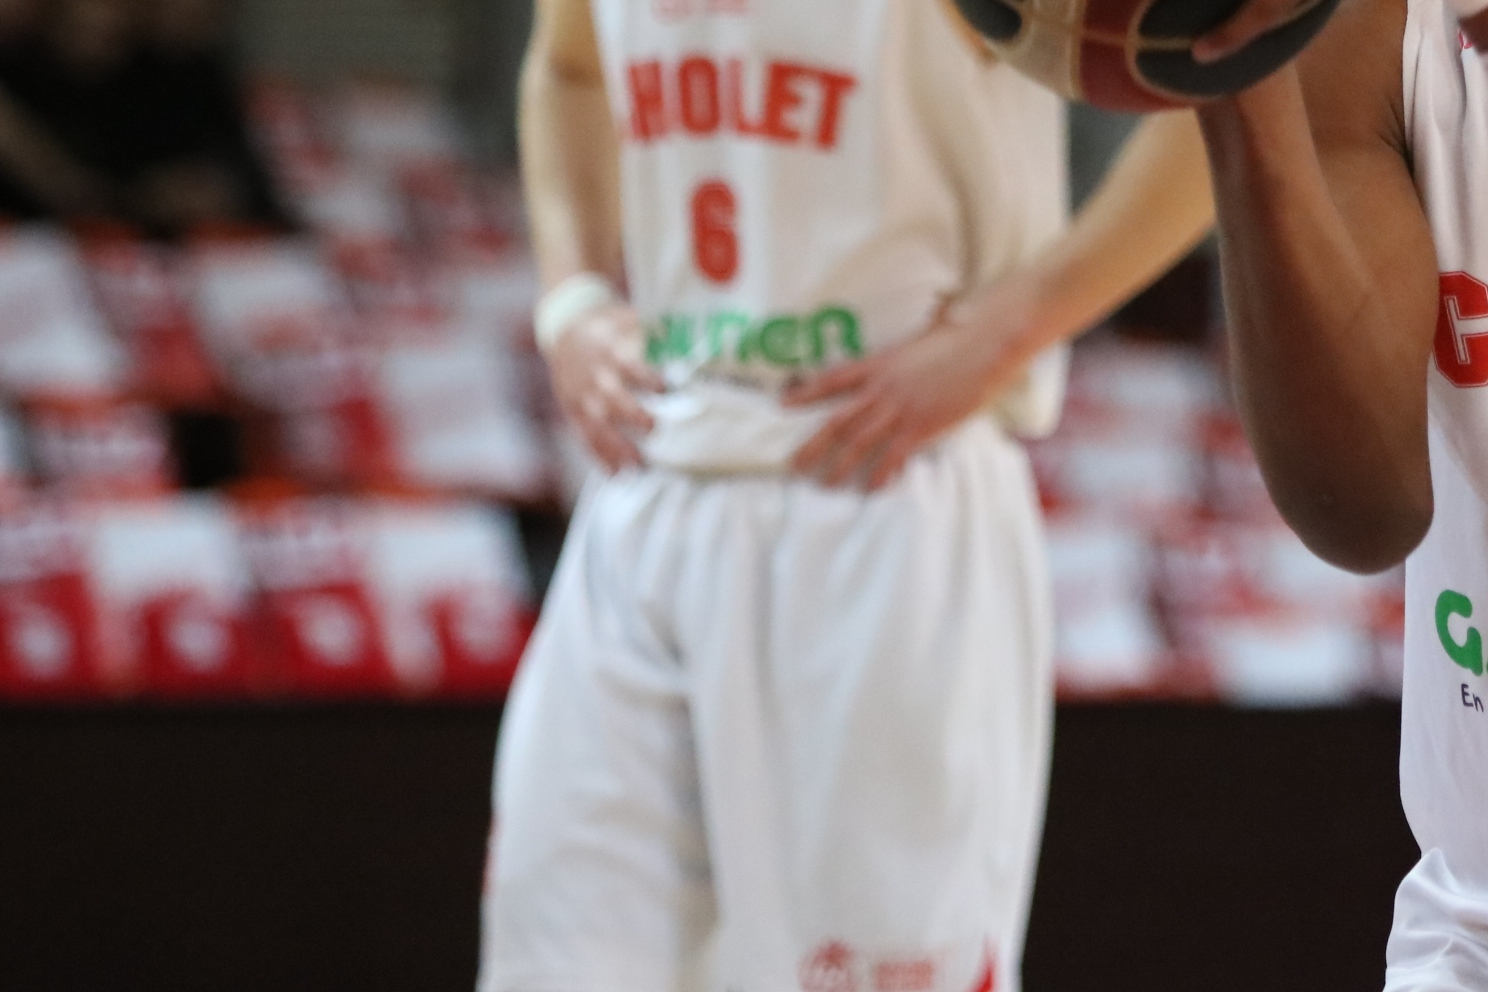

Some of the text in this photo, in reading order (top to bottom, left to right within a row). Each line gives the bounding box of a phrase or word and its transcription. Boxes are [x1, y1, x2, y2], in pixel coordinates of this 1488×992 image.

[625, 54, 858, 150] HOLET
[688, 176, 740, 284] 6
[1460, 683, 1484, 713] En
